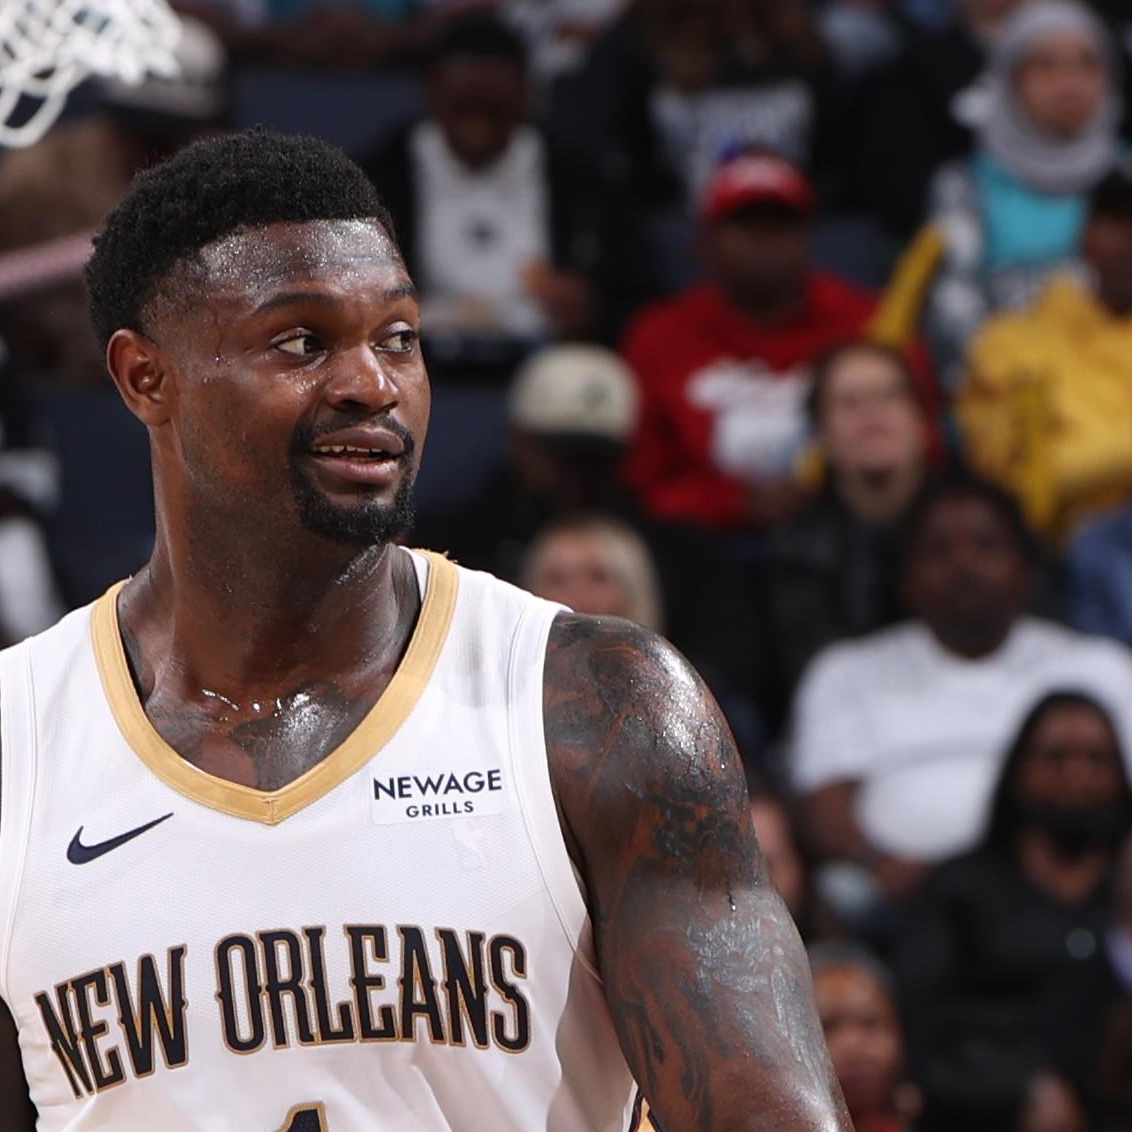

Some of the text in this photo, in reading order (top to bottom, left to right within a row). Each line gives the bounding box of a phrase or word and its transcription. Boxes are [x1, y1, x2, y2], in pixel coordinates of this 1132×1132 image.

[373, 769, 502, 800] NEWAGE
[406, 801, 474, 818] GRILLS
[33, 924, 532, 1099] NEW ORLEANS
